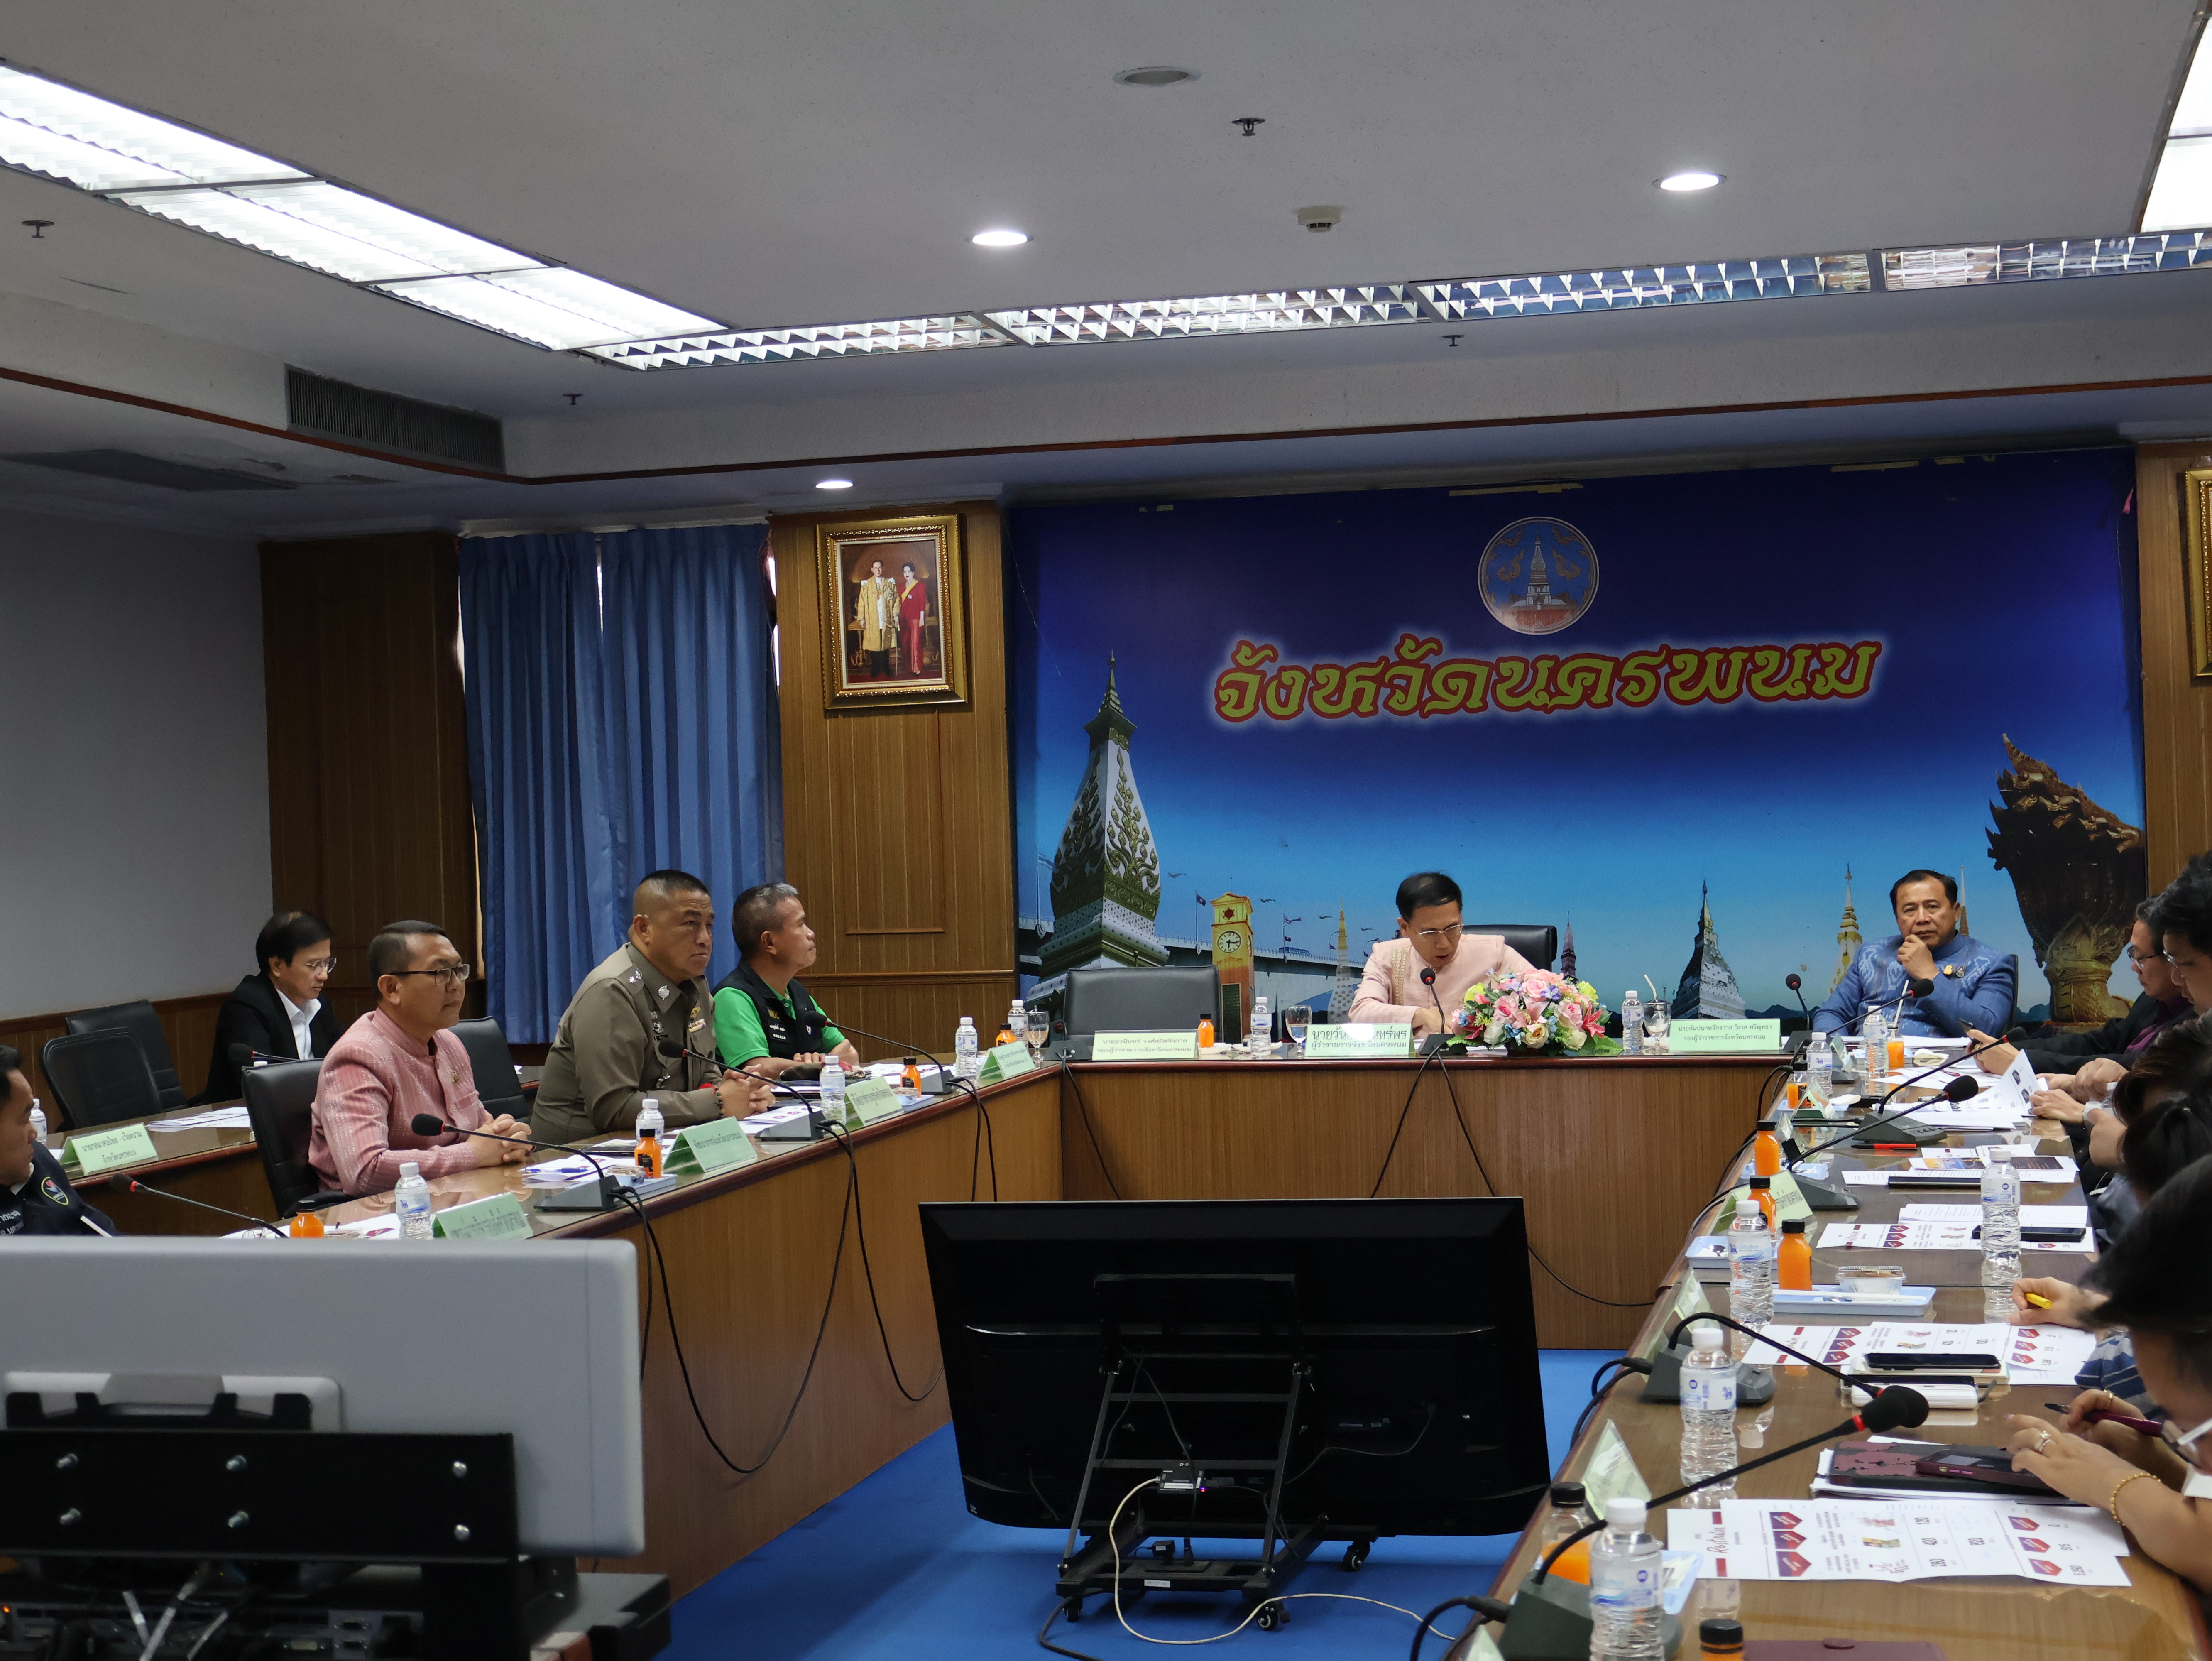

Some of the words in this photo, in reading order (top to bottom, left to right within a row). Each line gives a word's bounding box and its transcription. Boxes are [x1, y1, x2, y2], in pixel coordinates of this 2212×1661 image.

[1215, 633, 1882, 723] จังหวัดนครพนม
[1683, 1034, 1766, 1042] รองผู้ว่าราชการจังหวัดนครพนม
[1311, 1040, 1407, 1051] ผู้ว่าราชการจังหวัดนครพนม
